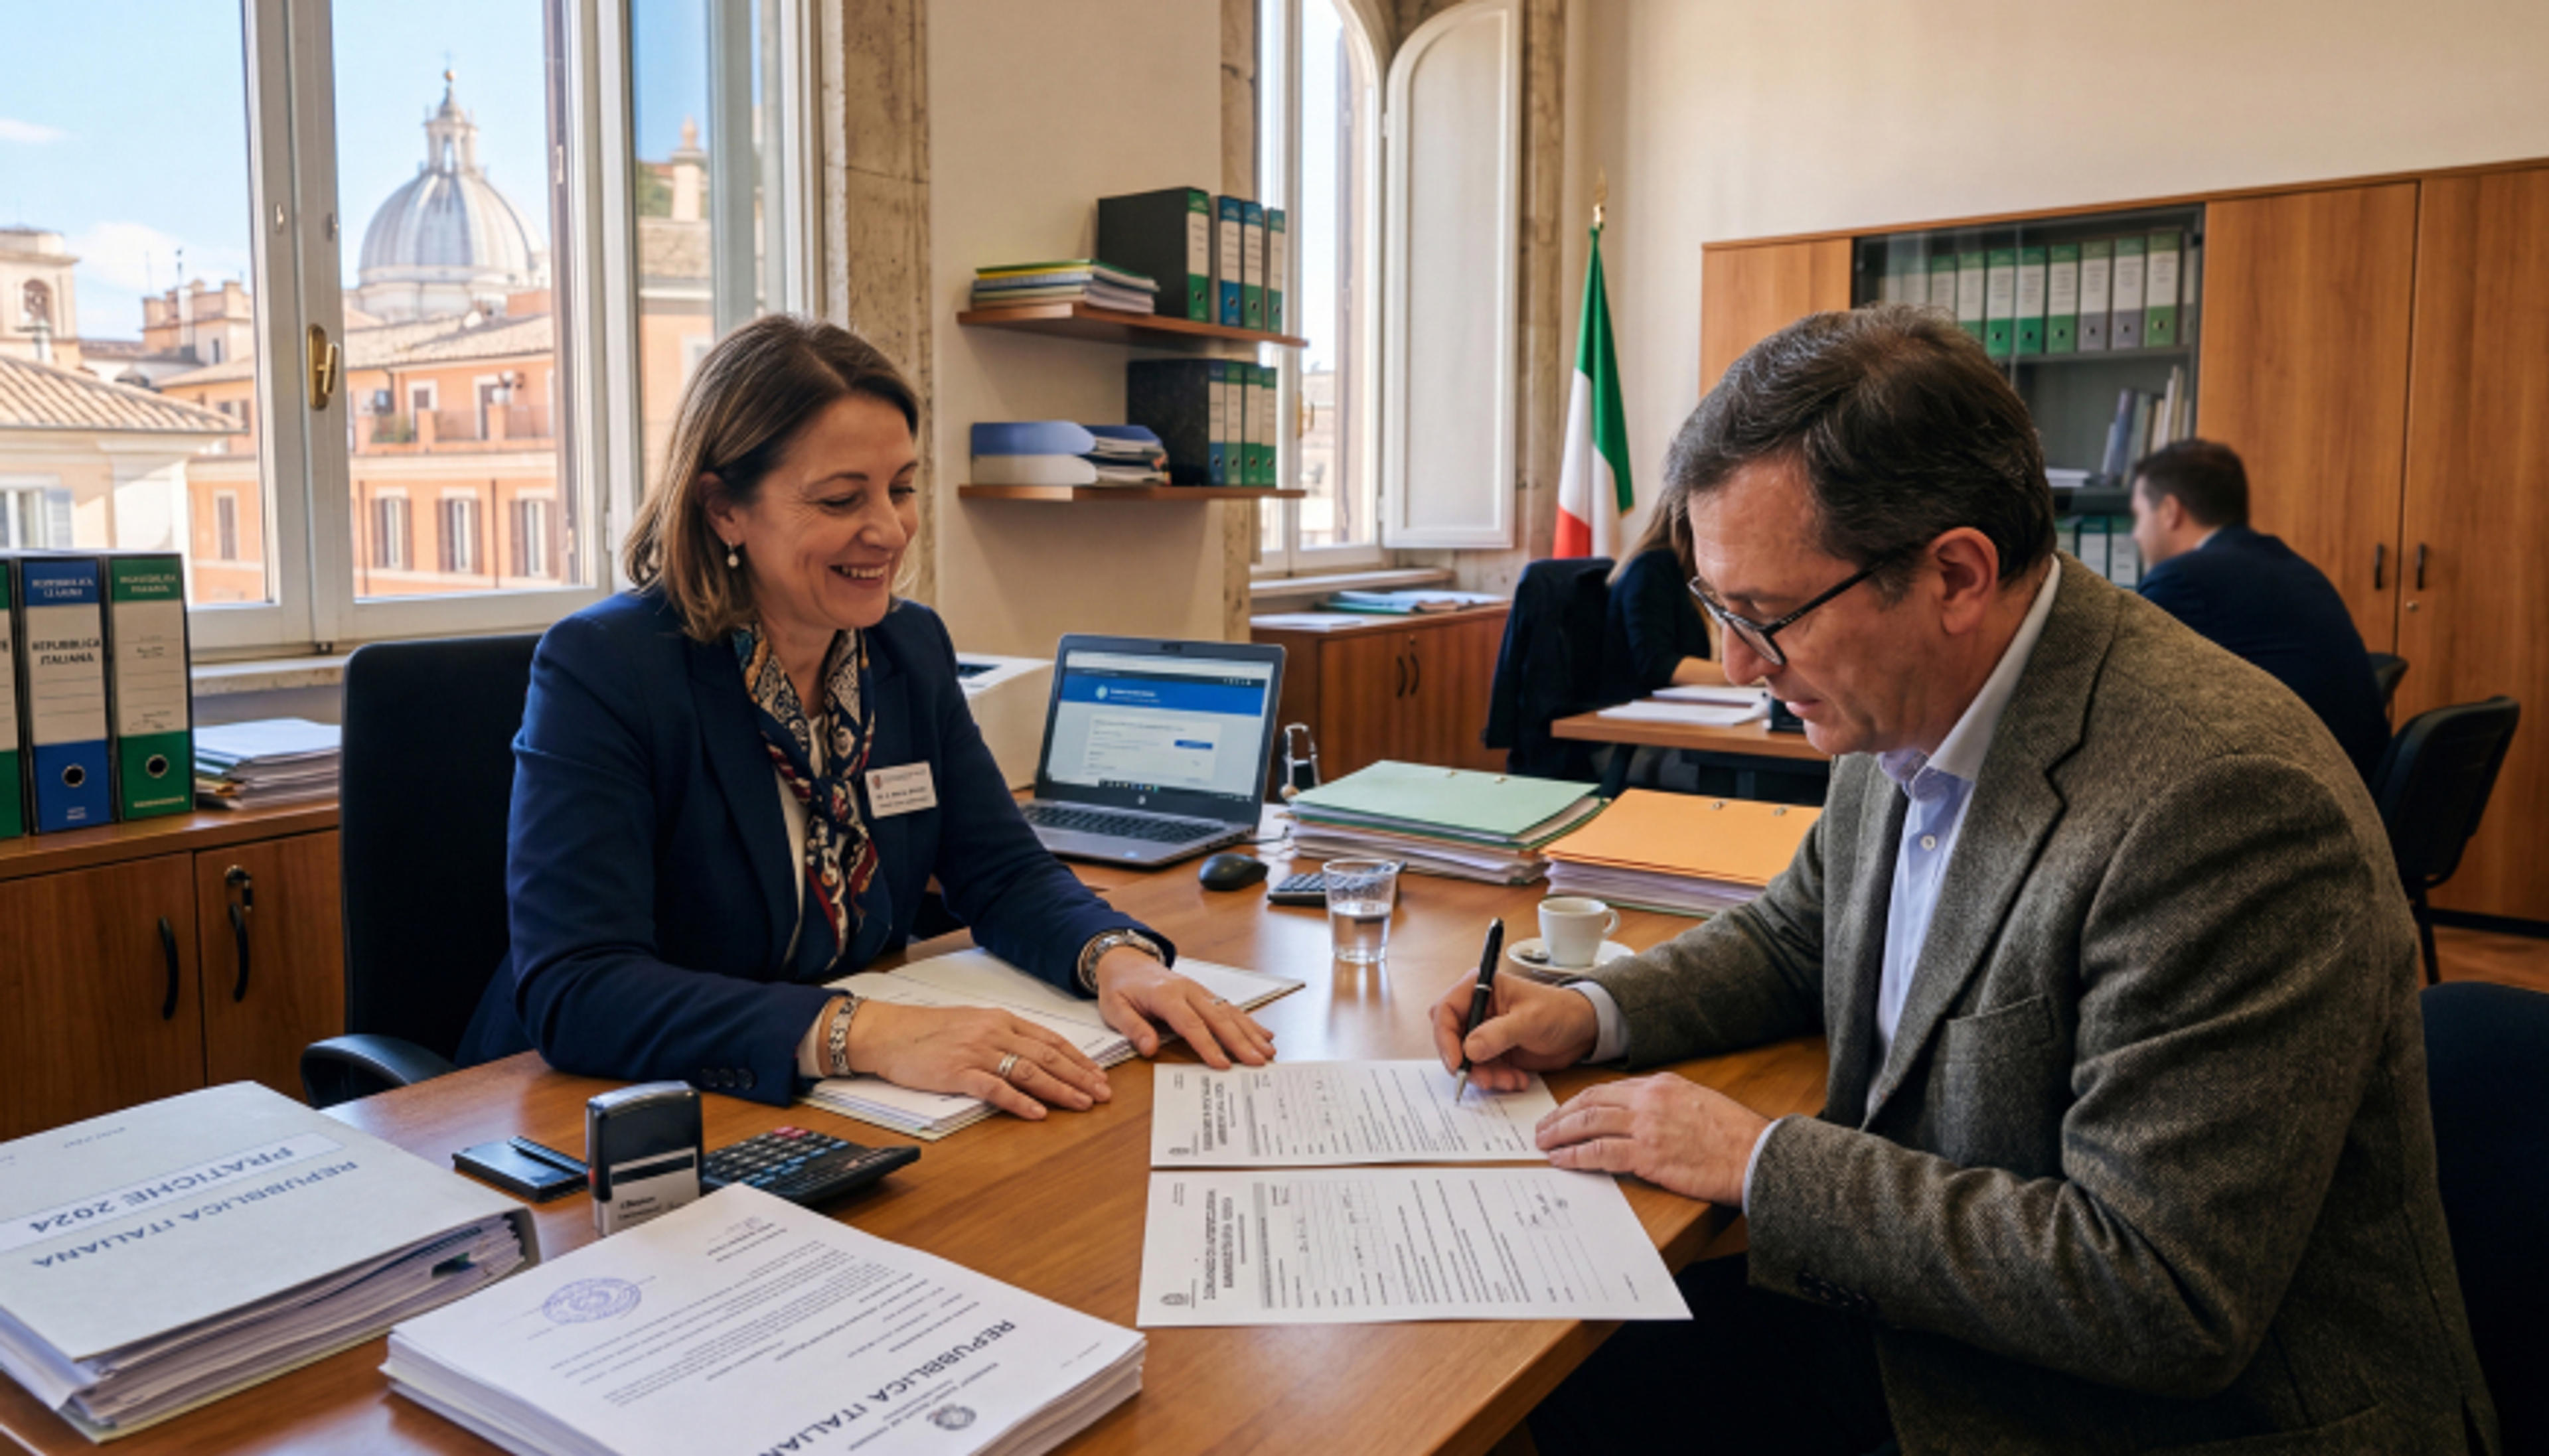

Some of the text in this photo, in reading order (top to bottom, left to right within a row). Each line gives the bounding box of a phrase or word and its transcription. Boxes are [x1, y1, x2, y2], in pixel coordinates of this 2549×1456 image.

[29, 1146, 295, 1234] PRATICHE 2024
[31, 1160, 358, 1268] REPUBBLICA ITALIANA
[866, 1319, 1016, 1404] REPUBBLICA
[758, 1403, 869, 1456] ITALIAN
